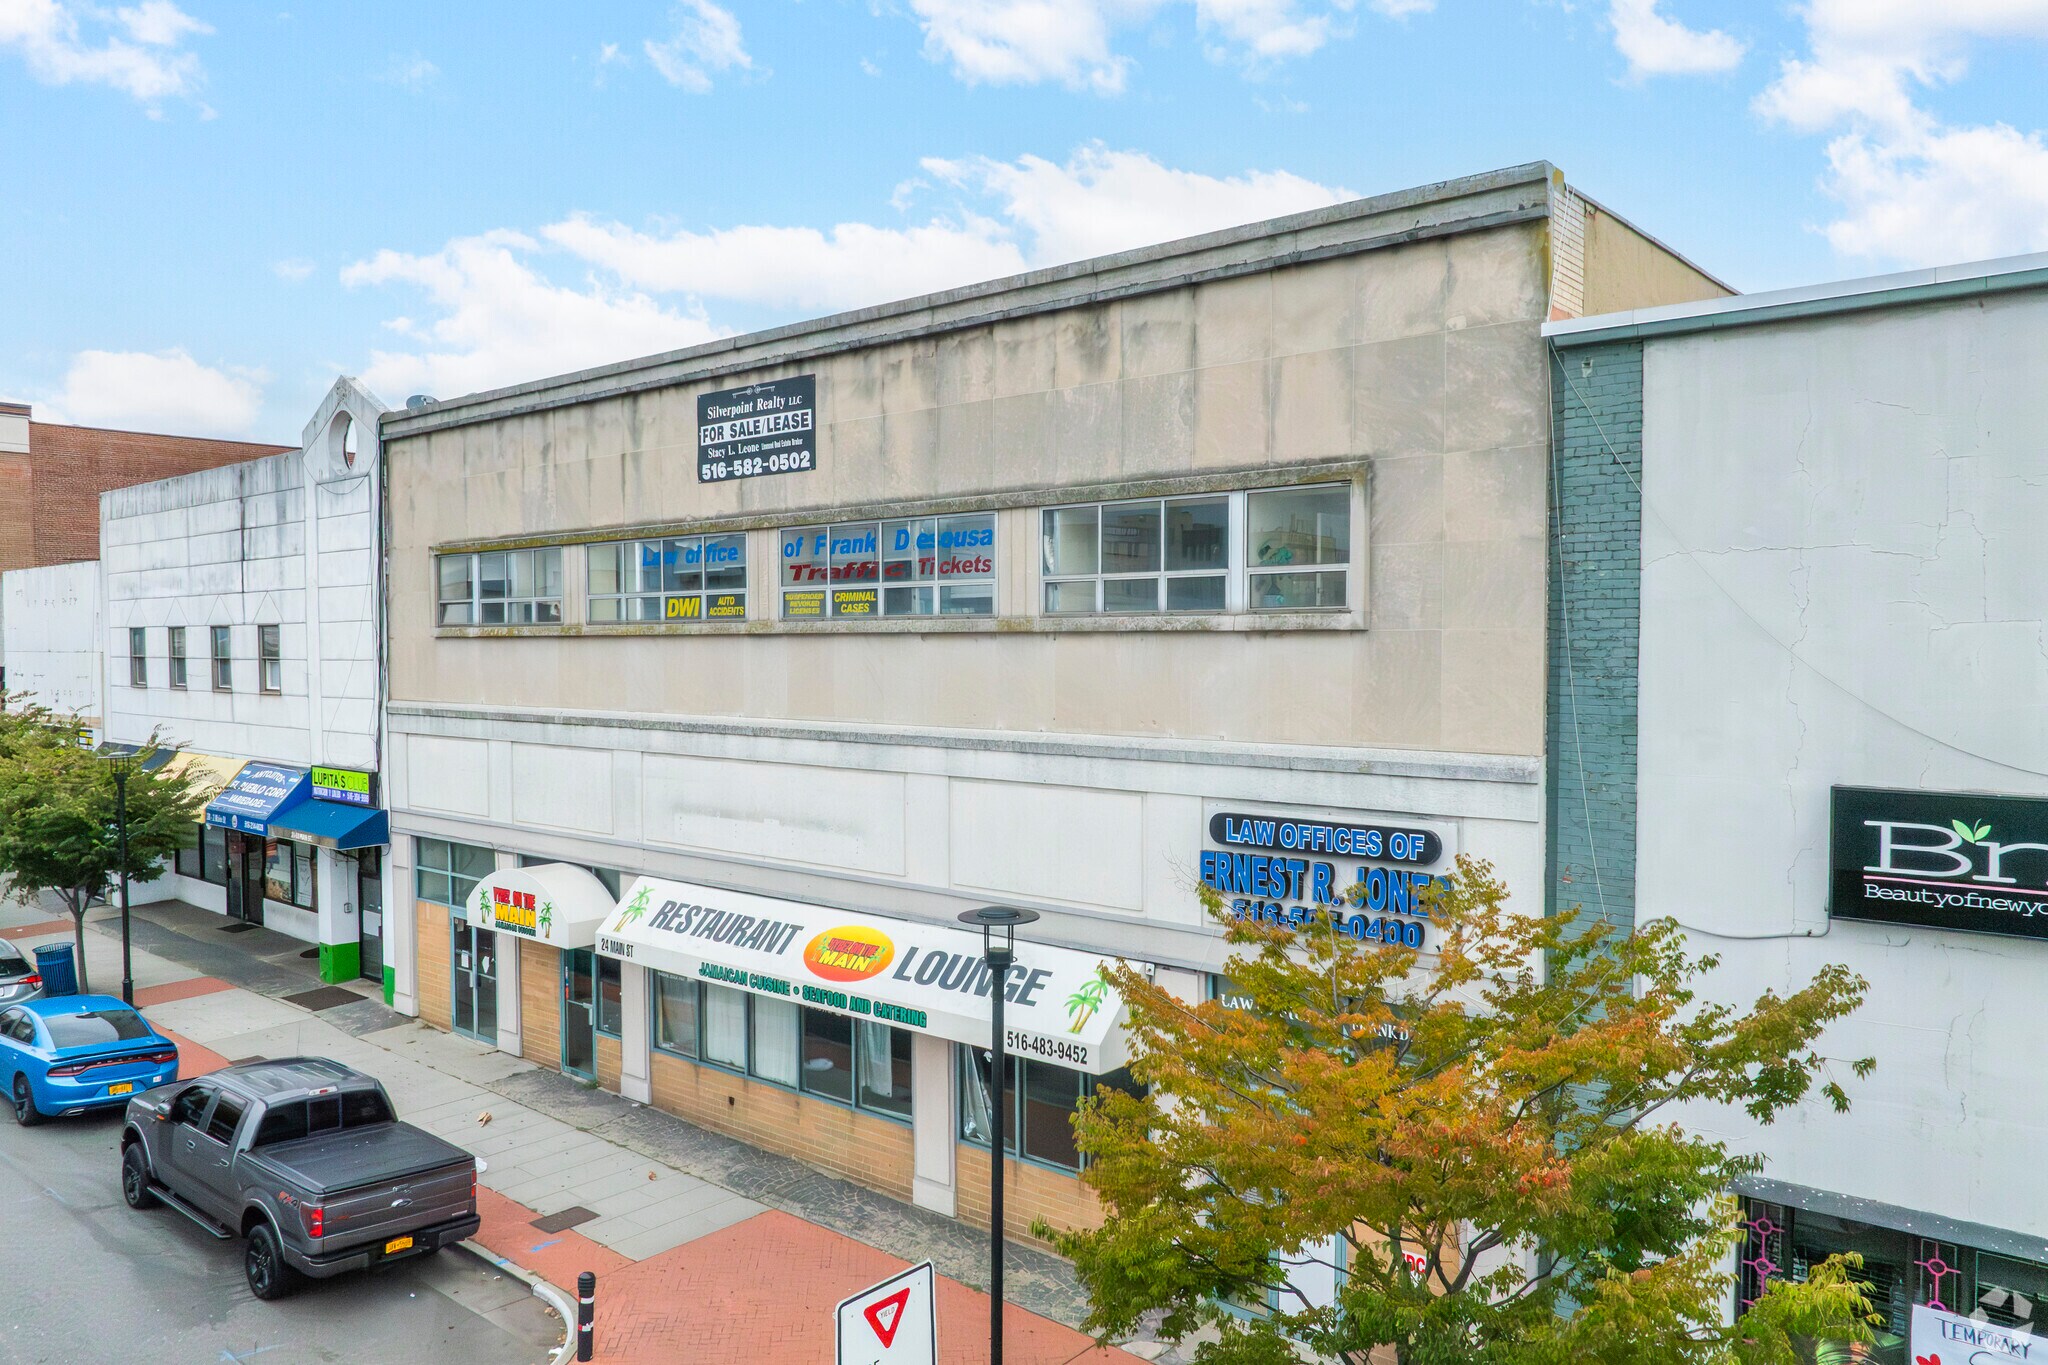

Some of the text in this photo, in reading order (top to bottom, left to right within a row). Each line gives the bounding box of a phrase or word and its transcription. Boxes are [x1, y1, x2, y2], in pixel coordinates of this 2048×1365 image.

[707, 395, 803, 419] Silverpoint Realty LLC
[702, 411, 810, 444] FOR SALE/LEASE
[707, 447, 726, 459] Stacy
[728, 444, 736, 456] L.
[738, 443, 760, 455] Leone
[701, 450, 811, 480] 516-582-0502
[685, 543, 739, 564] office
[783, 536, 804, 558] of
[814, 532, 877, 556] Frank
[789, 554, 992, 582] Traffic Tickets
[667, 597, 701, 618] DWI
[717, 596, 735, 606] AUTO
[833, 590, 877, 603] CRIMINAL
[708, 606, 745, 616] ACCIDENTS
[840, 602, 870, 614] CASES
[313, 771, 346, 788] LUPITA'S
[1225, 817, 1425, 861] LAW OFFICES OF
[1200, 850, 1308, 901] ERNEST
[1312, 862, 1343, 907] R.
[494, 902, 537, 929] MAIN
[647, 899, 804, 956] RESTAURANT
[601, 938, 634, 958] 24 MAIN ST
[817, 951, 872, 972] MAIN
[699, 962, 748, 987] JAMAICAN
[749, 973, 791, 996] CUISINE
[802, 984, 848, 1010] SEAFOOD
[849, 995, 871, 1015] AND
[873, 1002, 927, 1028] CATERING
[1220, 993, 1254, 1010] LAW
[1006, 1031, 1088, 1065] 516-483-9452
[880, 1306, 896, 1319] YIELD
[1935, 1317, 2032, 1359] TEMPORARY
